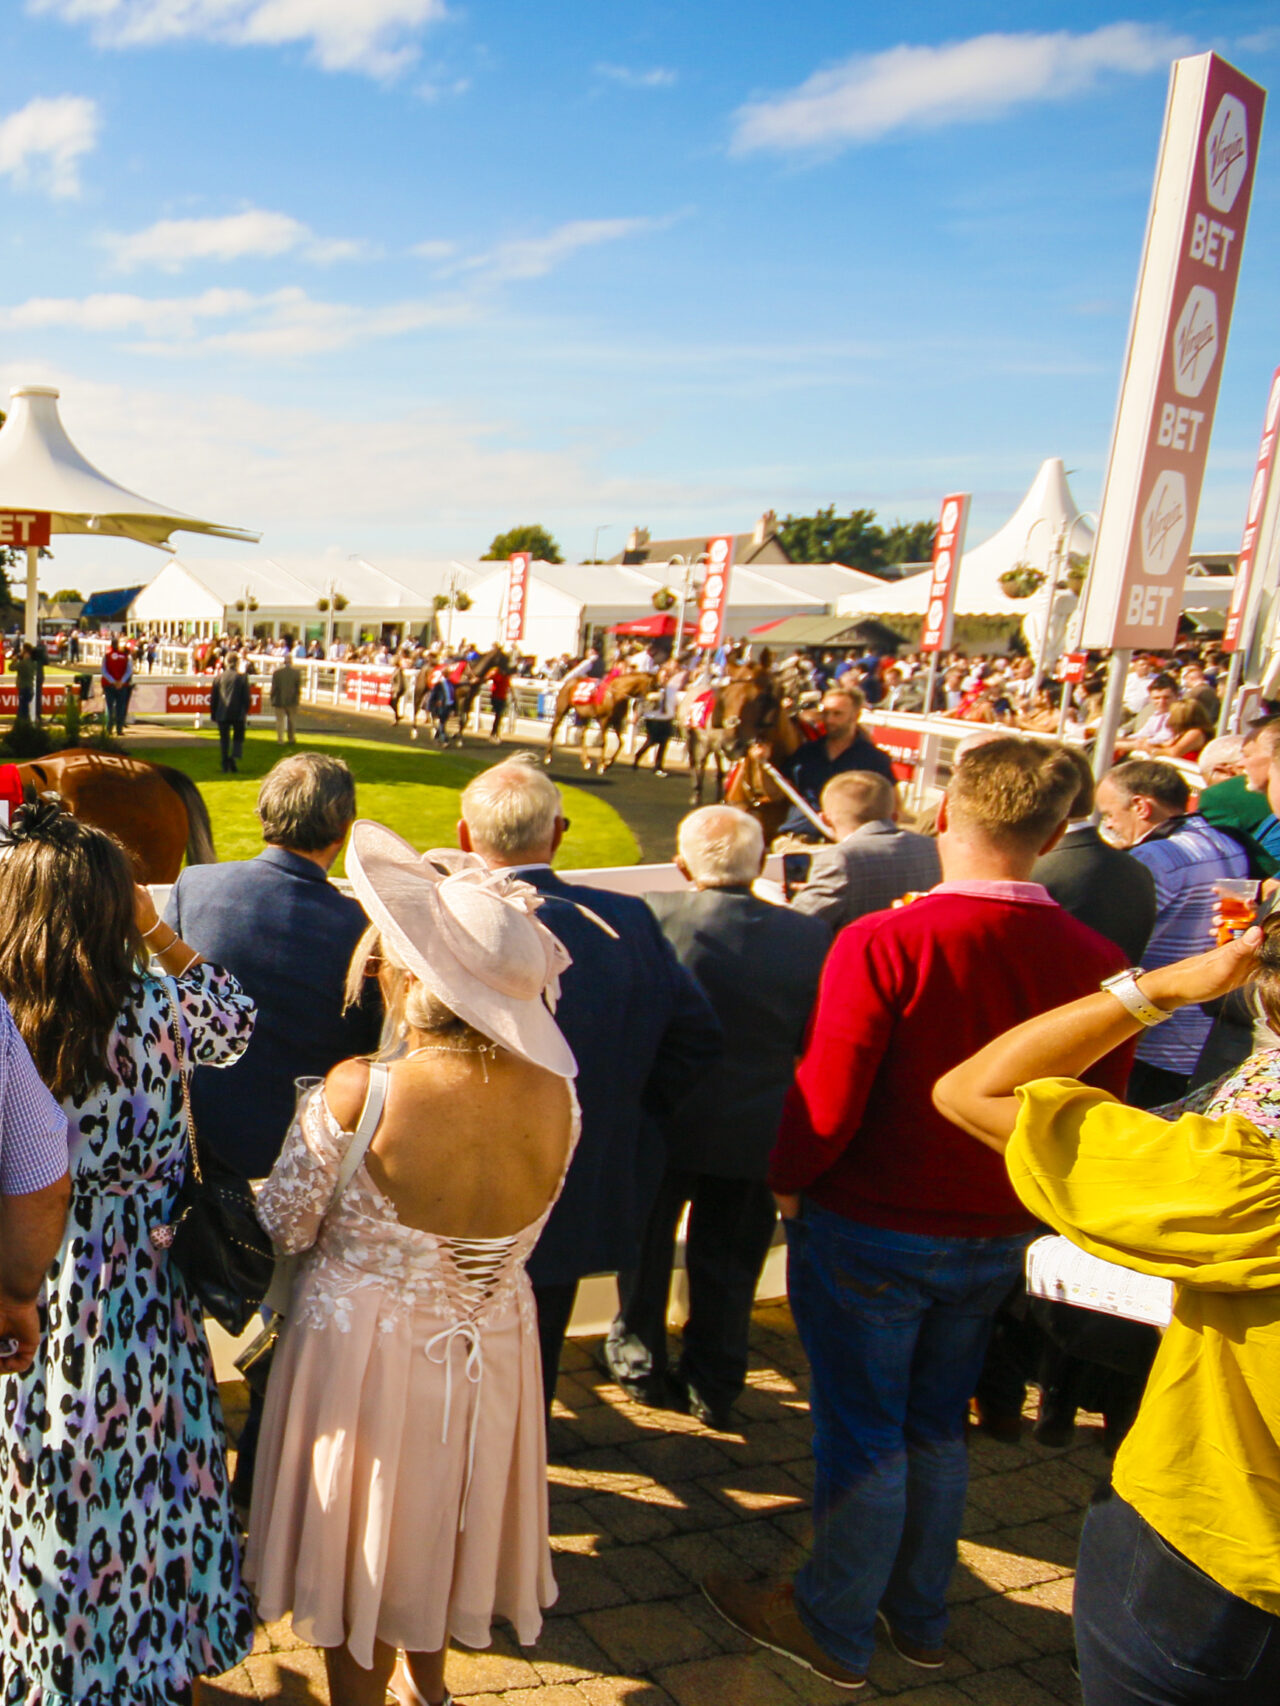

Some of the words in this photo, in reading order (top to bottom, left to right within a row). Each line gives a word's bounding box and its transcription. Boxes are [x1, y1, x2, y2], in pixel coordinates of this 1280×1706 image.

[1189, 212, 1236, 271] BET
[1157, 402, 1205, 453] BET
[1125, 584, 1174, 627] BET
